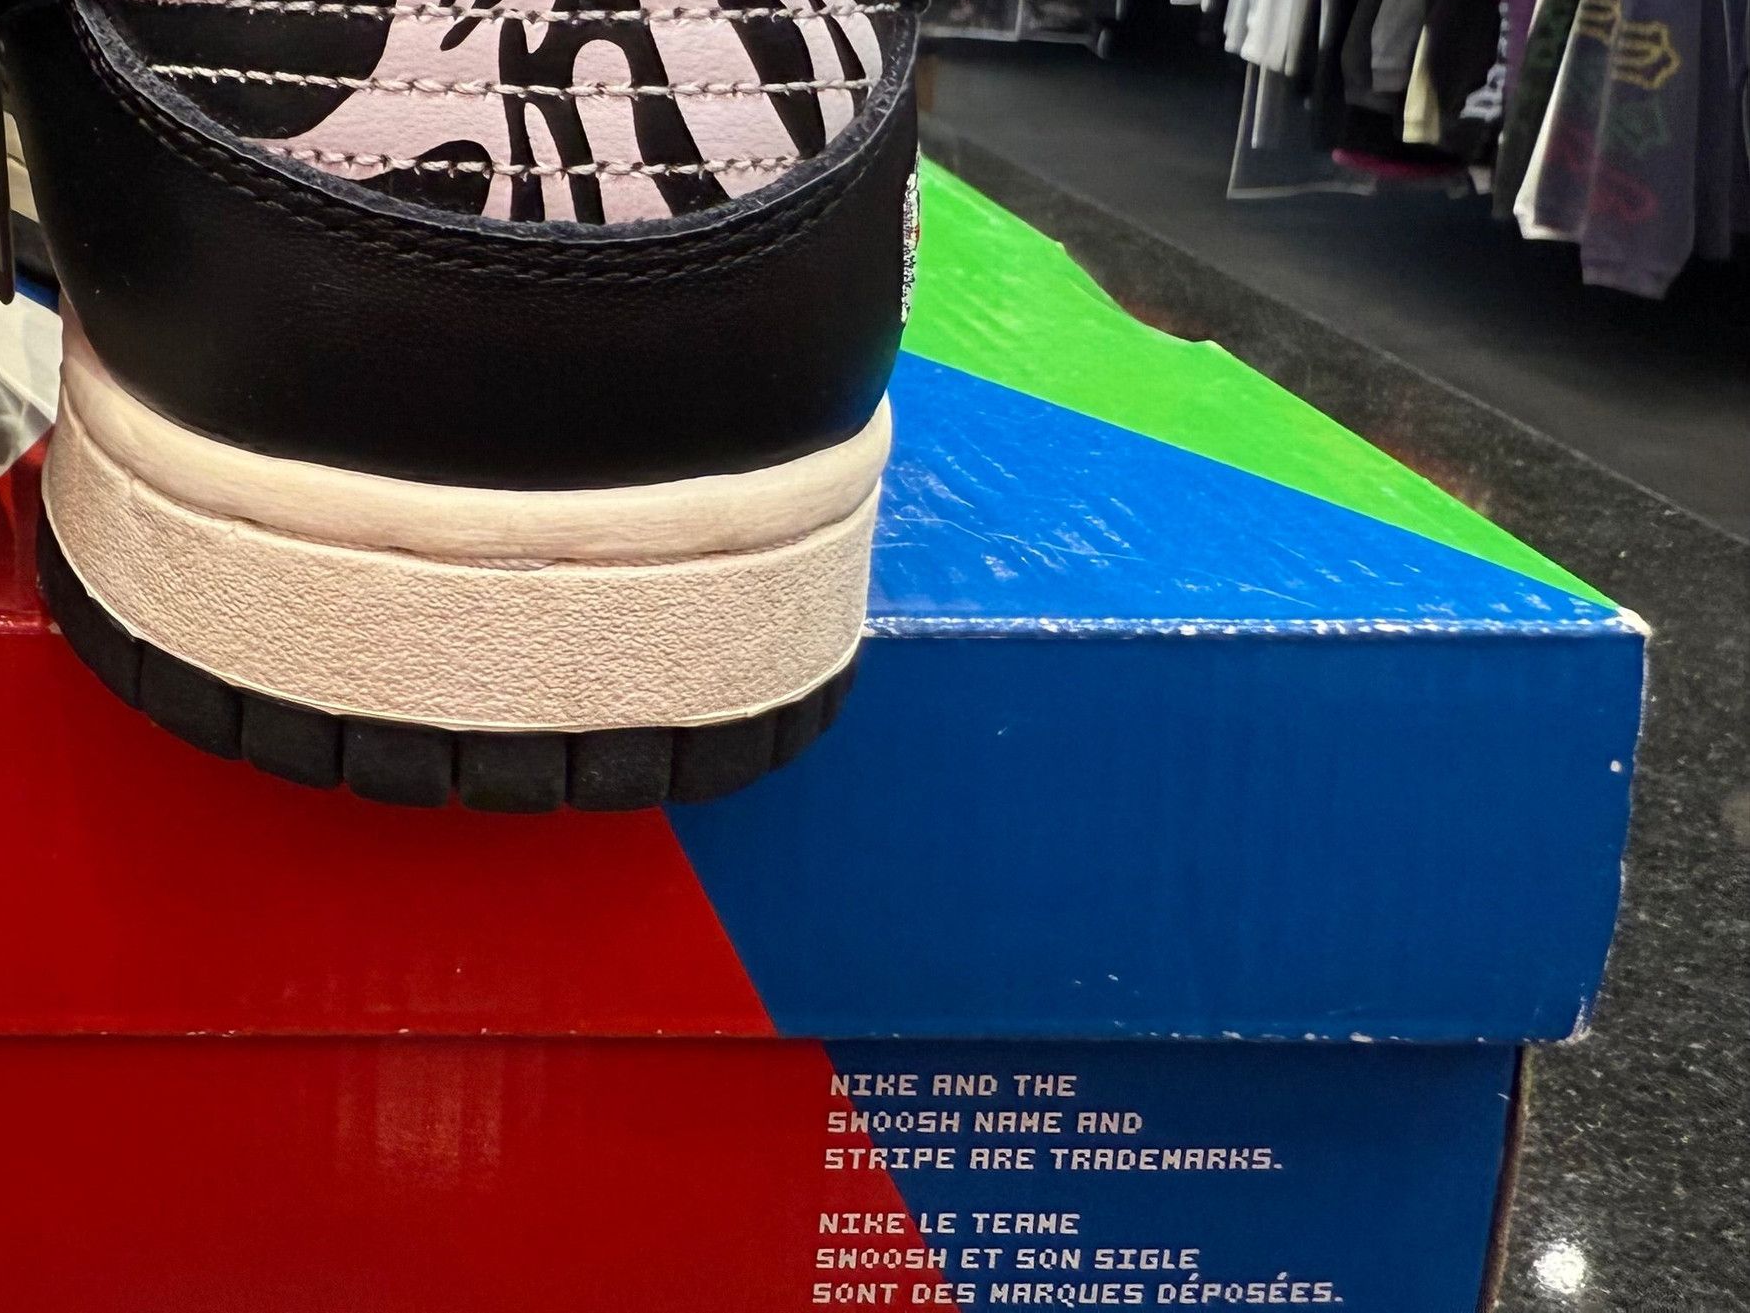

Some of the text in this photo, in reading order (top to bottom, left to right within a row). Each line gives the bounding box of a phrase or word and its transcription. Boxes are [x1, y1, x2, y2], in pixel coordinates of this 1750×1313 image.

[830, 1074, 1077, 1097] NIKE AND THE
[827, 1111, 1143, 1134] SWOOSH NAME AND
[824, 1147, 1283, 1171] STRIPE ARE TRADEMARKS.
[819, 1212, 907, 1235] NIKE
[919, 1212, 957, 1234] LE
[815, 1247, 1200, 1270] SWOOSH ET SON SIGLE
[812, 1271, 1343, 1308] SONT DES MARQUES DÉPOSÉES.
